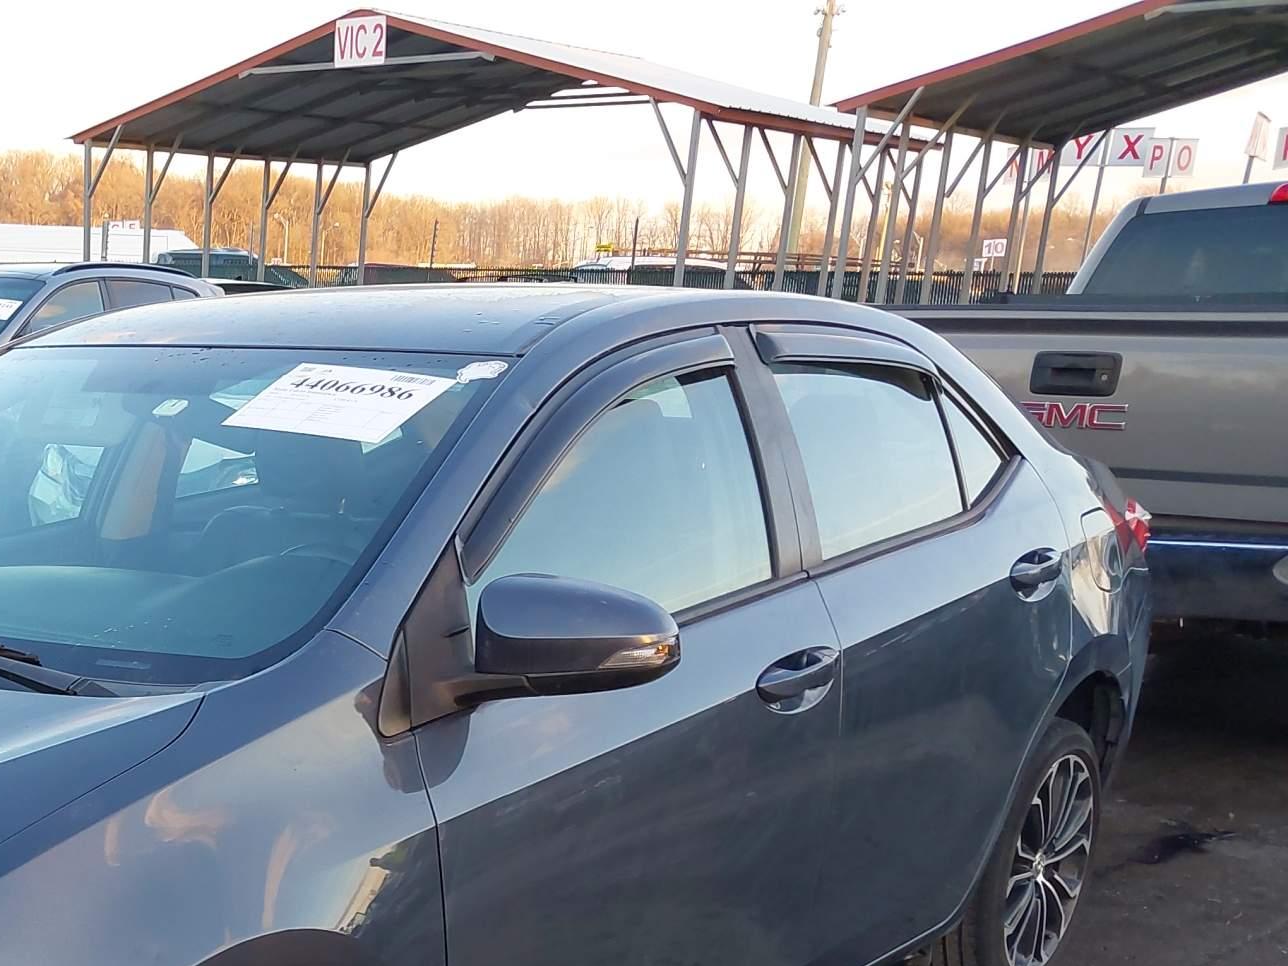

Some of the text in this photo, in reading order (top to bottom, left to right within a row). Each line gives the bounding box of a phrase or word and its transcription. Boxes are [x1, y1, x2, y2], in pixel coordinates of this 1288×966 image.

[338, 23, 384, 60] VIC 2
[1074, 133, 1145, 160] Y X
[1149, 144, 1164, 171] P
[290, 376, 419, 401] 44066986
